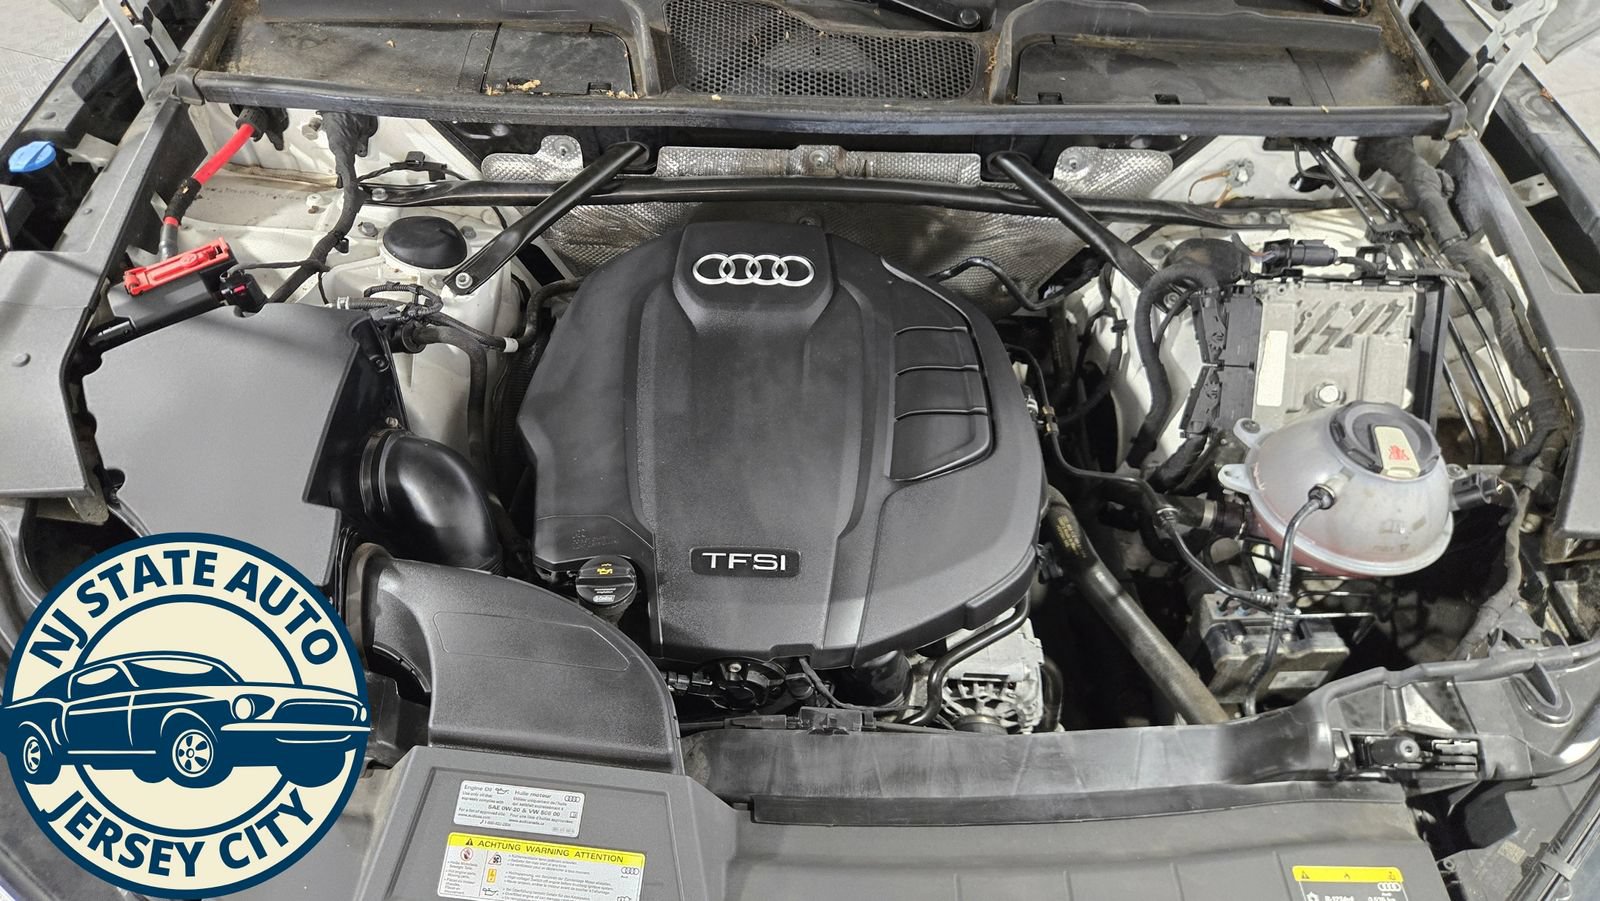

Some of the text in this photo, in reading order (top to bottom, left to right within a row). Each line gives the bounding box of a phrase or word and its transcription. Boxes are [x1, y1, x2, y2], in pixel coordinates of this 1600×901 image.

[702, 552, 786, 571] TFSI
[477, 840, 521, 851] ACHTUNG
[526, 845, 570, 857] WARNING
[574, 851, 624, 863] ATTENTION
